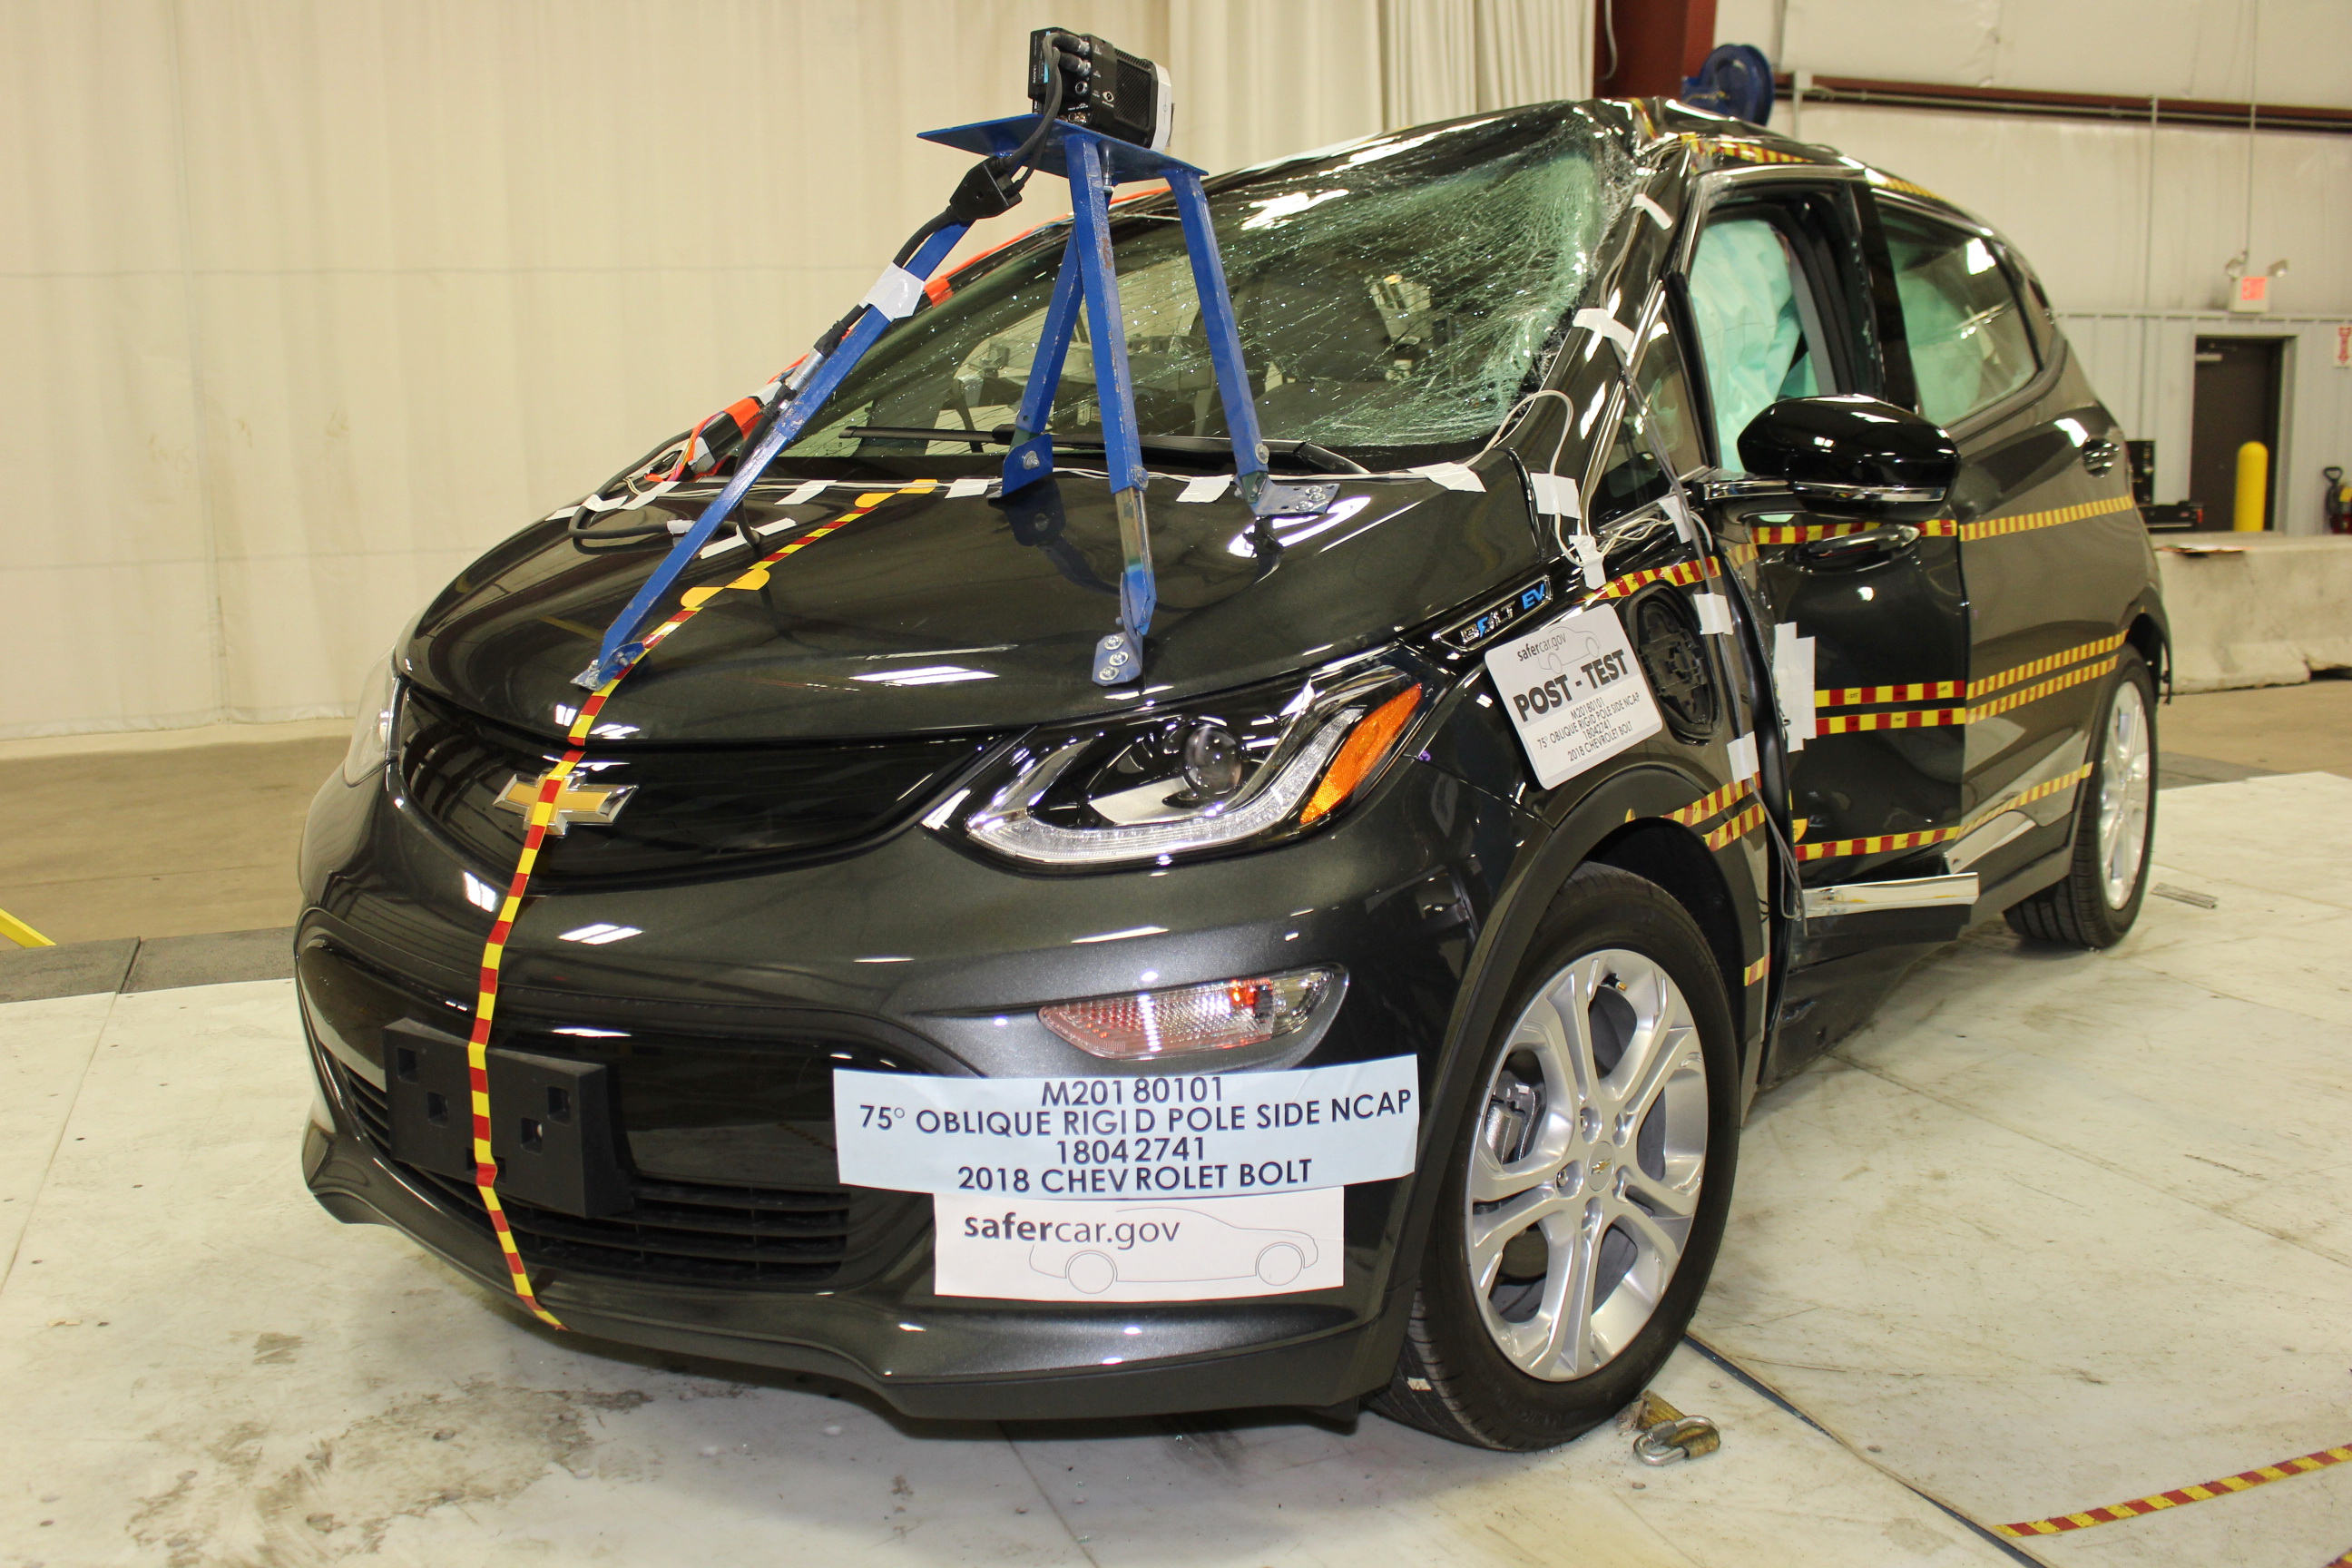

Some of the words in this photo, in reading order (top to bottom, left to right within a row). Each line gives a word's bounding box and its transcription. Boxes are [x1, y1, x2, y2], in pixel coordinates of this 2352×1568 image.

[1522, 583, 1544, 610] EV
[1517, 633, 1566, 662] safercar.gov
[1513, 674, 1573, 722] POST
[1581, 649, 1629, 690] TEST
[1537, 736, 1549, 750] 75°
[1549, 722, 1579, 744] OBLIQUE
[1577, 713, 1597, 730] RIGID
[1595, 706, 1612, 720] POLE
[1611, 700, 1625, 714] SIDE
[1623, 691, 1641, 707] NCAP
[1570, 697, 1605, 721] M20180101
[1567, 745, 1585, 762] 2018
[1584, 729, 1619, 753] CHEVROLET
[1618, 720, 1633, 736] BOLT
[1582, 719, 1612, 740] 18042741
[1042, 1076, 1222, 1107] M20180101
[860, 1104, 905, 1131] 75°
[916, 1109, 1051, 1138] OBLIQUE
[1063, 1107, 1156, 1135] RIGID
[1169, 1105, 1246, 1133] POLE
[1257, 1100, 1320, 1129] SIDE
[1332, 1089, 1412, 1122] NCAP
[1056, 1136, 1204, 1165] 18042741
[958, 1166, 1031, 1193] 2018
[1041, 1164, 1229, 1193] CHEVROLET
[1240, 1158, 1312, 1188] BOLT
[965, 1211, 1181, 1250] safercar.gov
